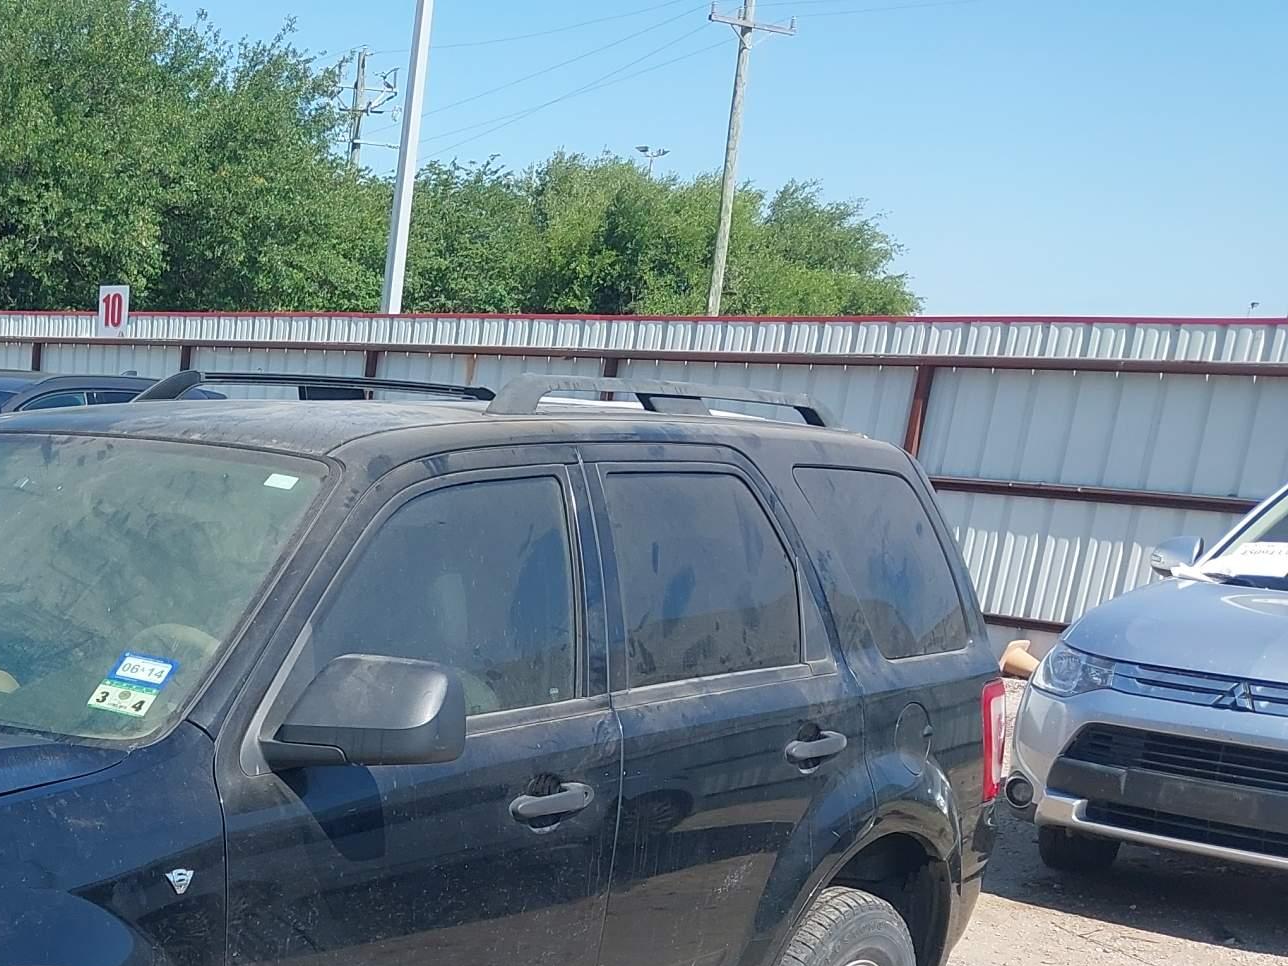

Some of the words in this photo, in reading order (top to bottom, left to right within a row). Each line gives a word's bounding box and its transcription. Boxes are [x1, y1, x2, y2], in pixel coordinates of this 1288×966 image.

[102, 292, 123, 328] 10
[121, 662, 141, 674] 06
[95, 691, 110, 703] 3
[131, 700, 146, 712] 4
